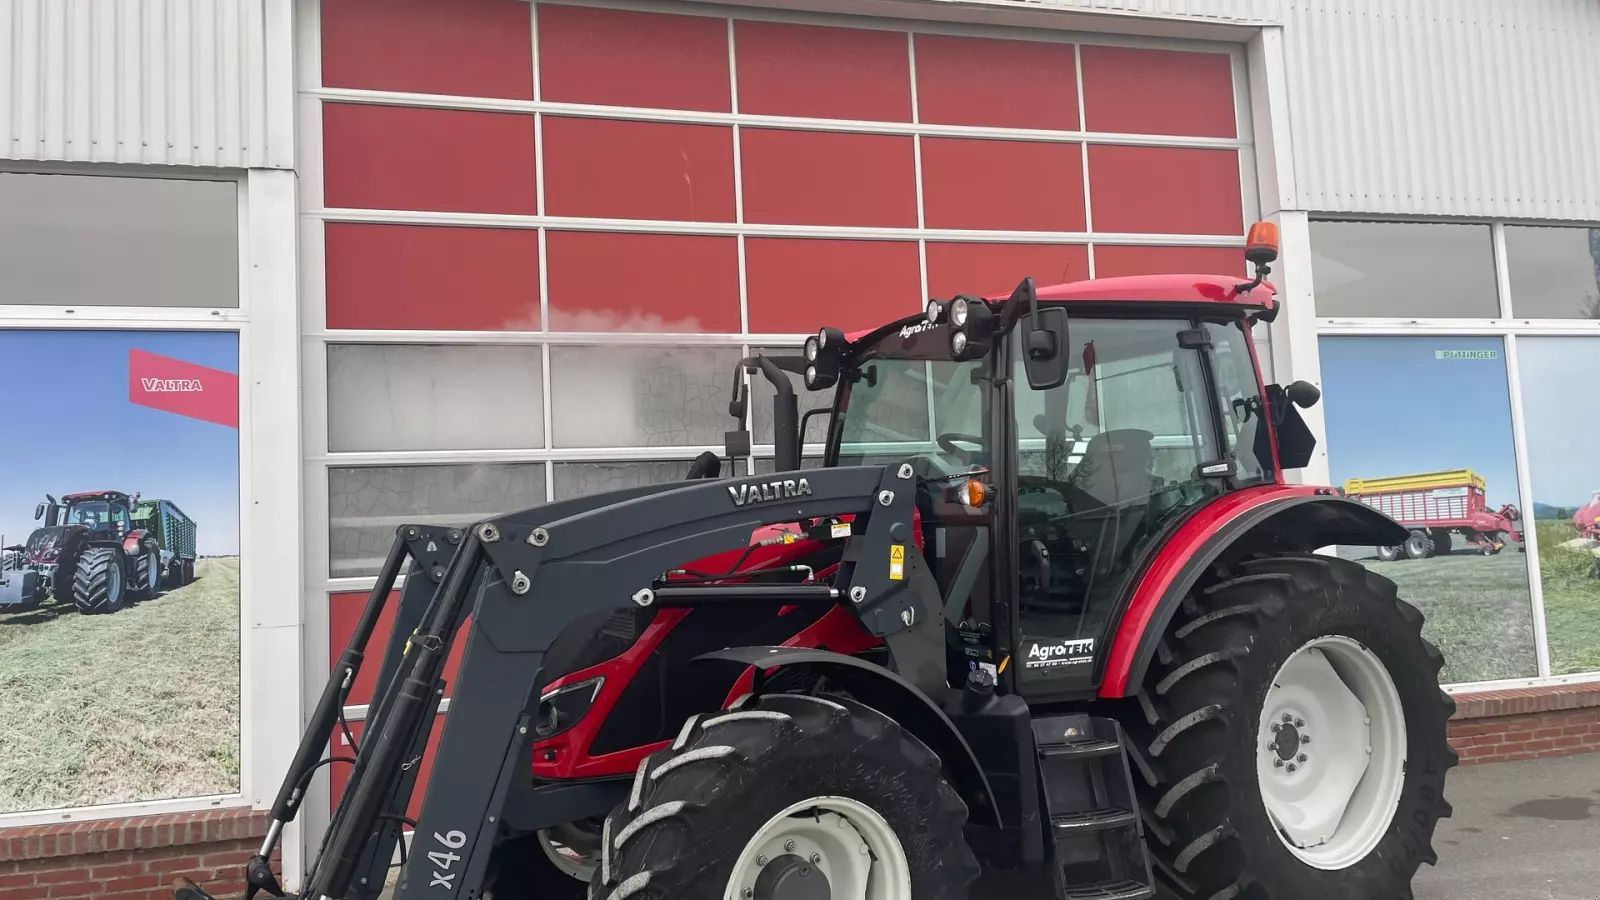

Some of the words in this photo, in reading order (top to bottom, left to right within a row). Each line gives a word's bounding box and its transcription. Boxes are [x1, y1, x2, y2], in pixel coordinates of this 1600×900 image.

[141, 378, 203, 392] VALTRA
[728, 478, 812, 506] VALTRA
[1028, 638, 1094, 660] AgroTEK
[427, 830, 467, 890] x46
